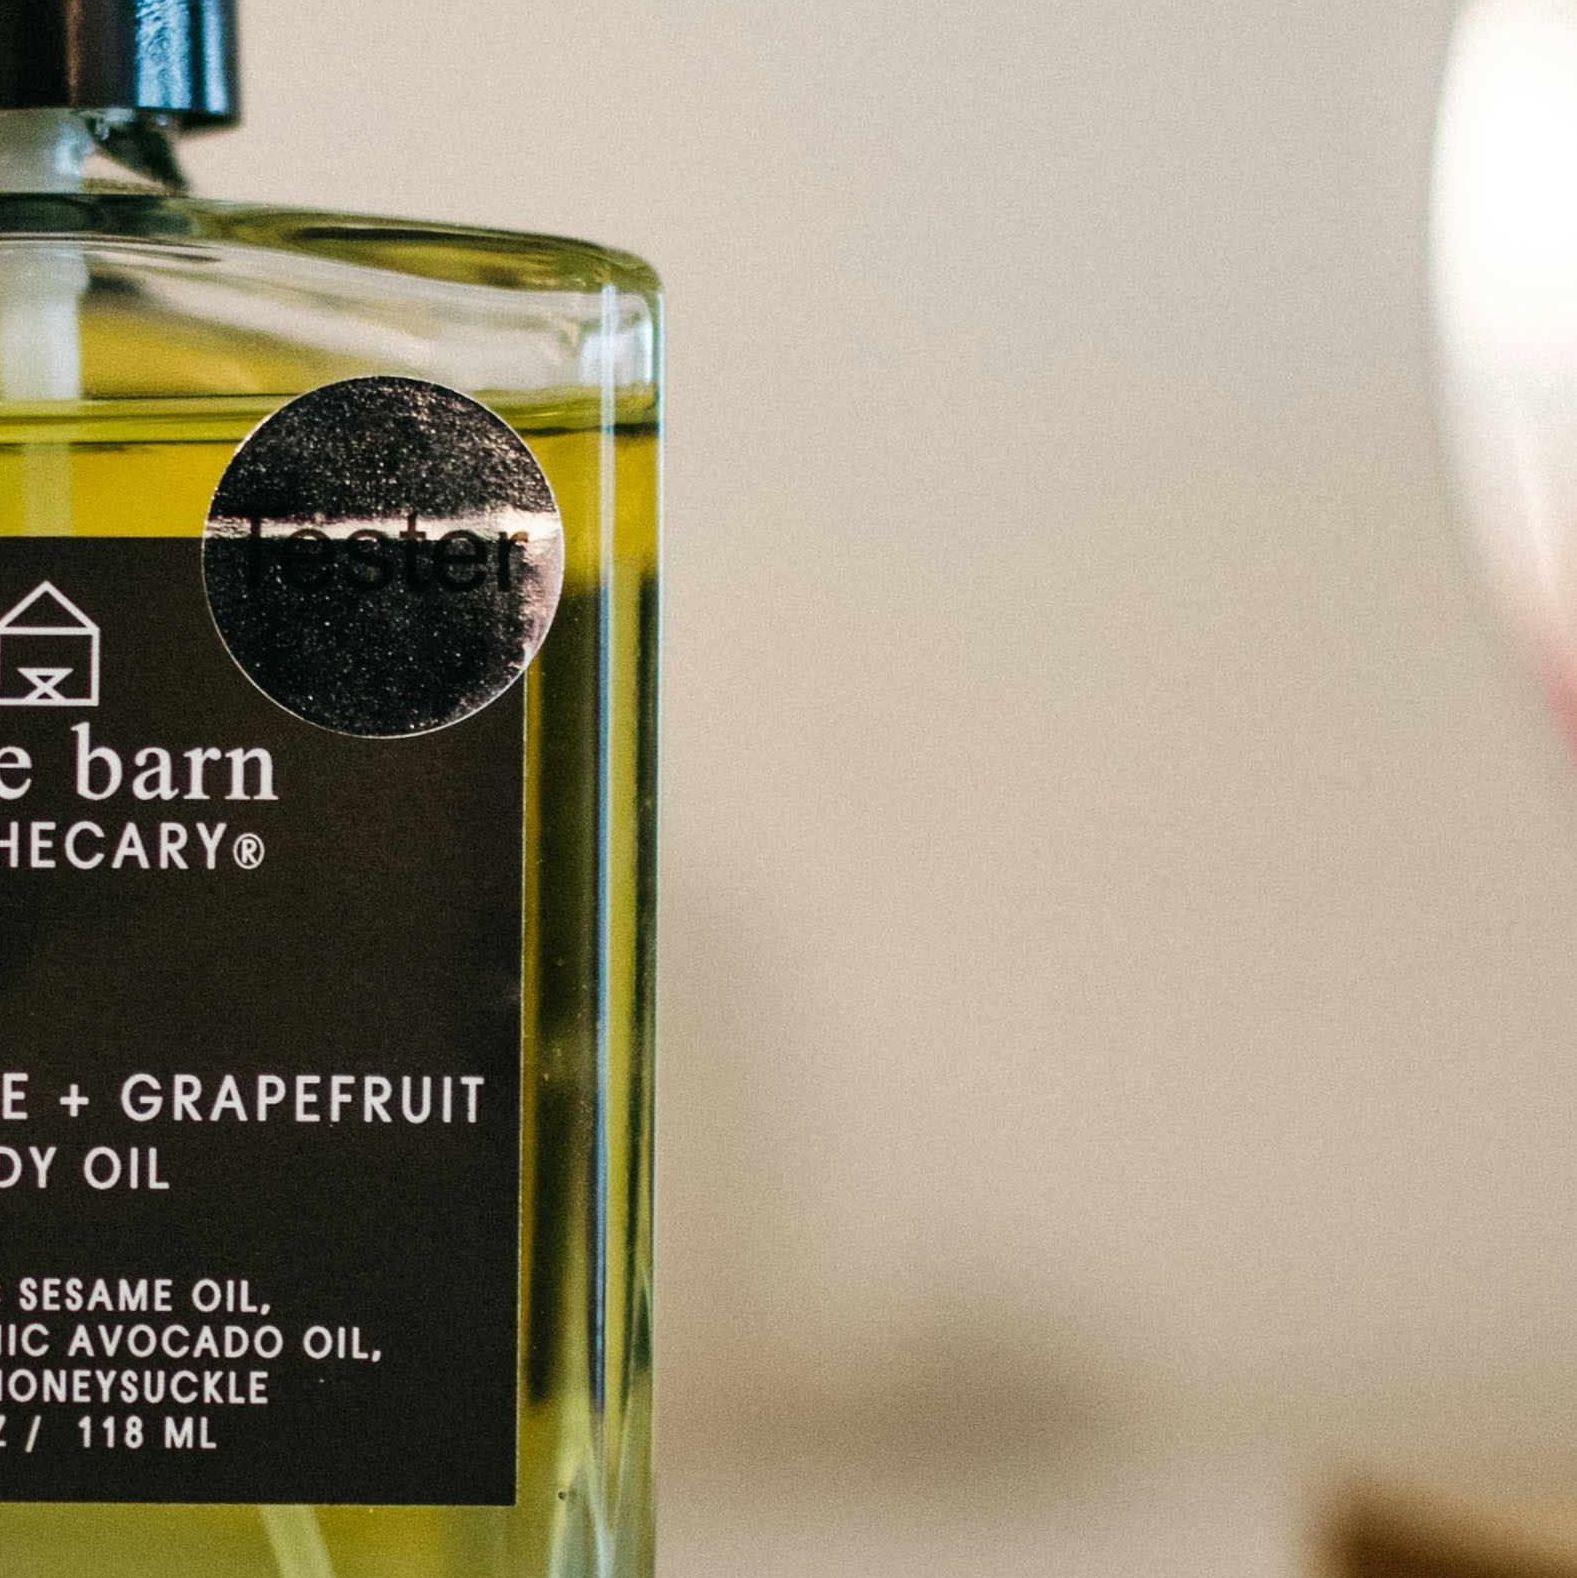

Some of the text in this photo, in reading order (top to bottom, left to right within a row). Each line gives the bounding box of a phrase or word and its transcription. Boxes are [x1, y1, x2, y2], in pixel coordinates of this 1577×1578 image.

[70, 721, 279, 801] barn
[59, 1083, 90, 1118] +
[120, 1072, 485, 1124] GRAPEFRUIT
[83, 1146, 170, 1190] OIL
[19, 1277, 173, 1312] SESAME
[191, 1278, 271, 1316] OIL,
[67, 1323, 284, 1359] AVOCADO
[302, 1325, 382, 1363] OIL,
[78, 1415, 144, 1449] 118
[164, 1416, 217, 1449] ML
